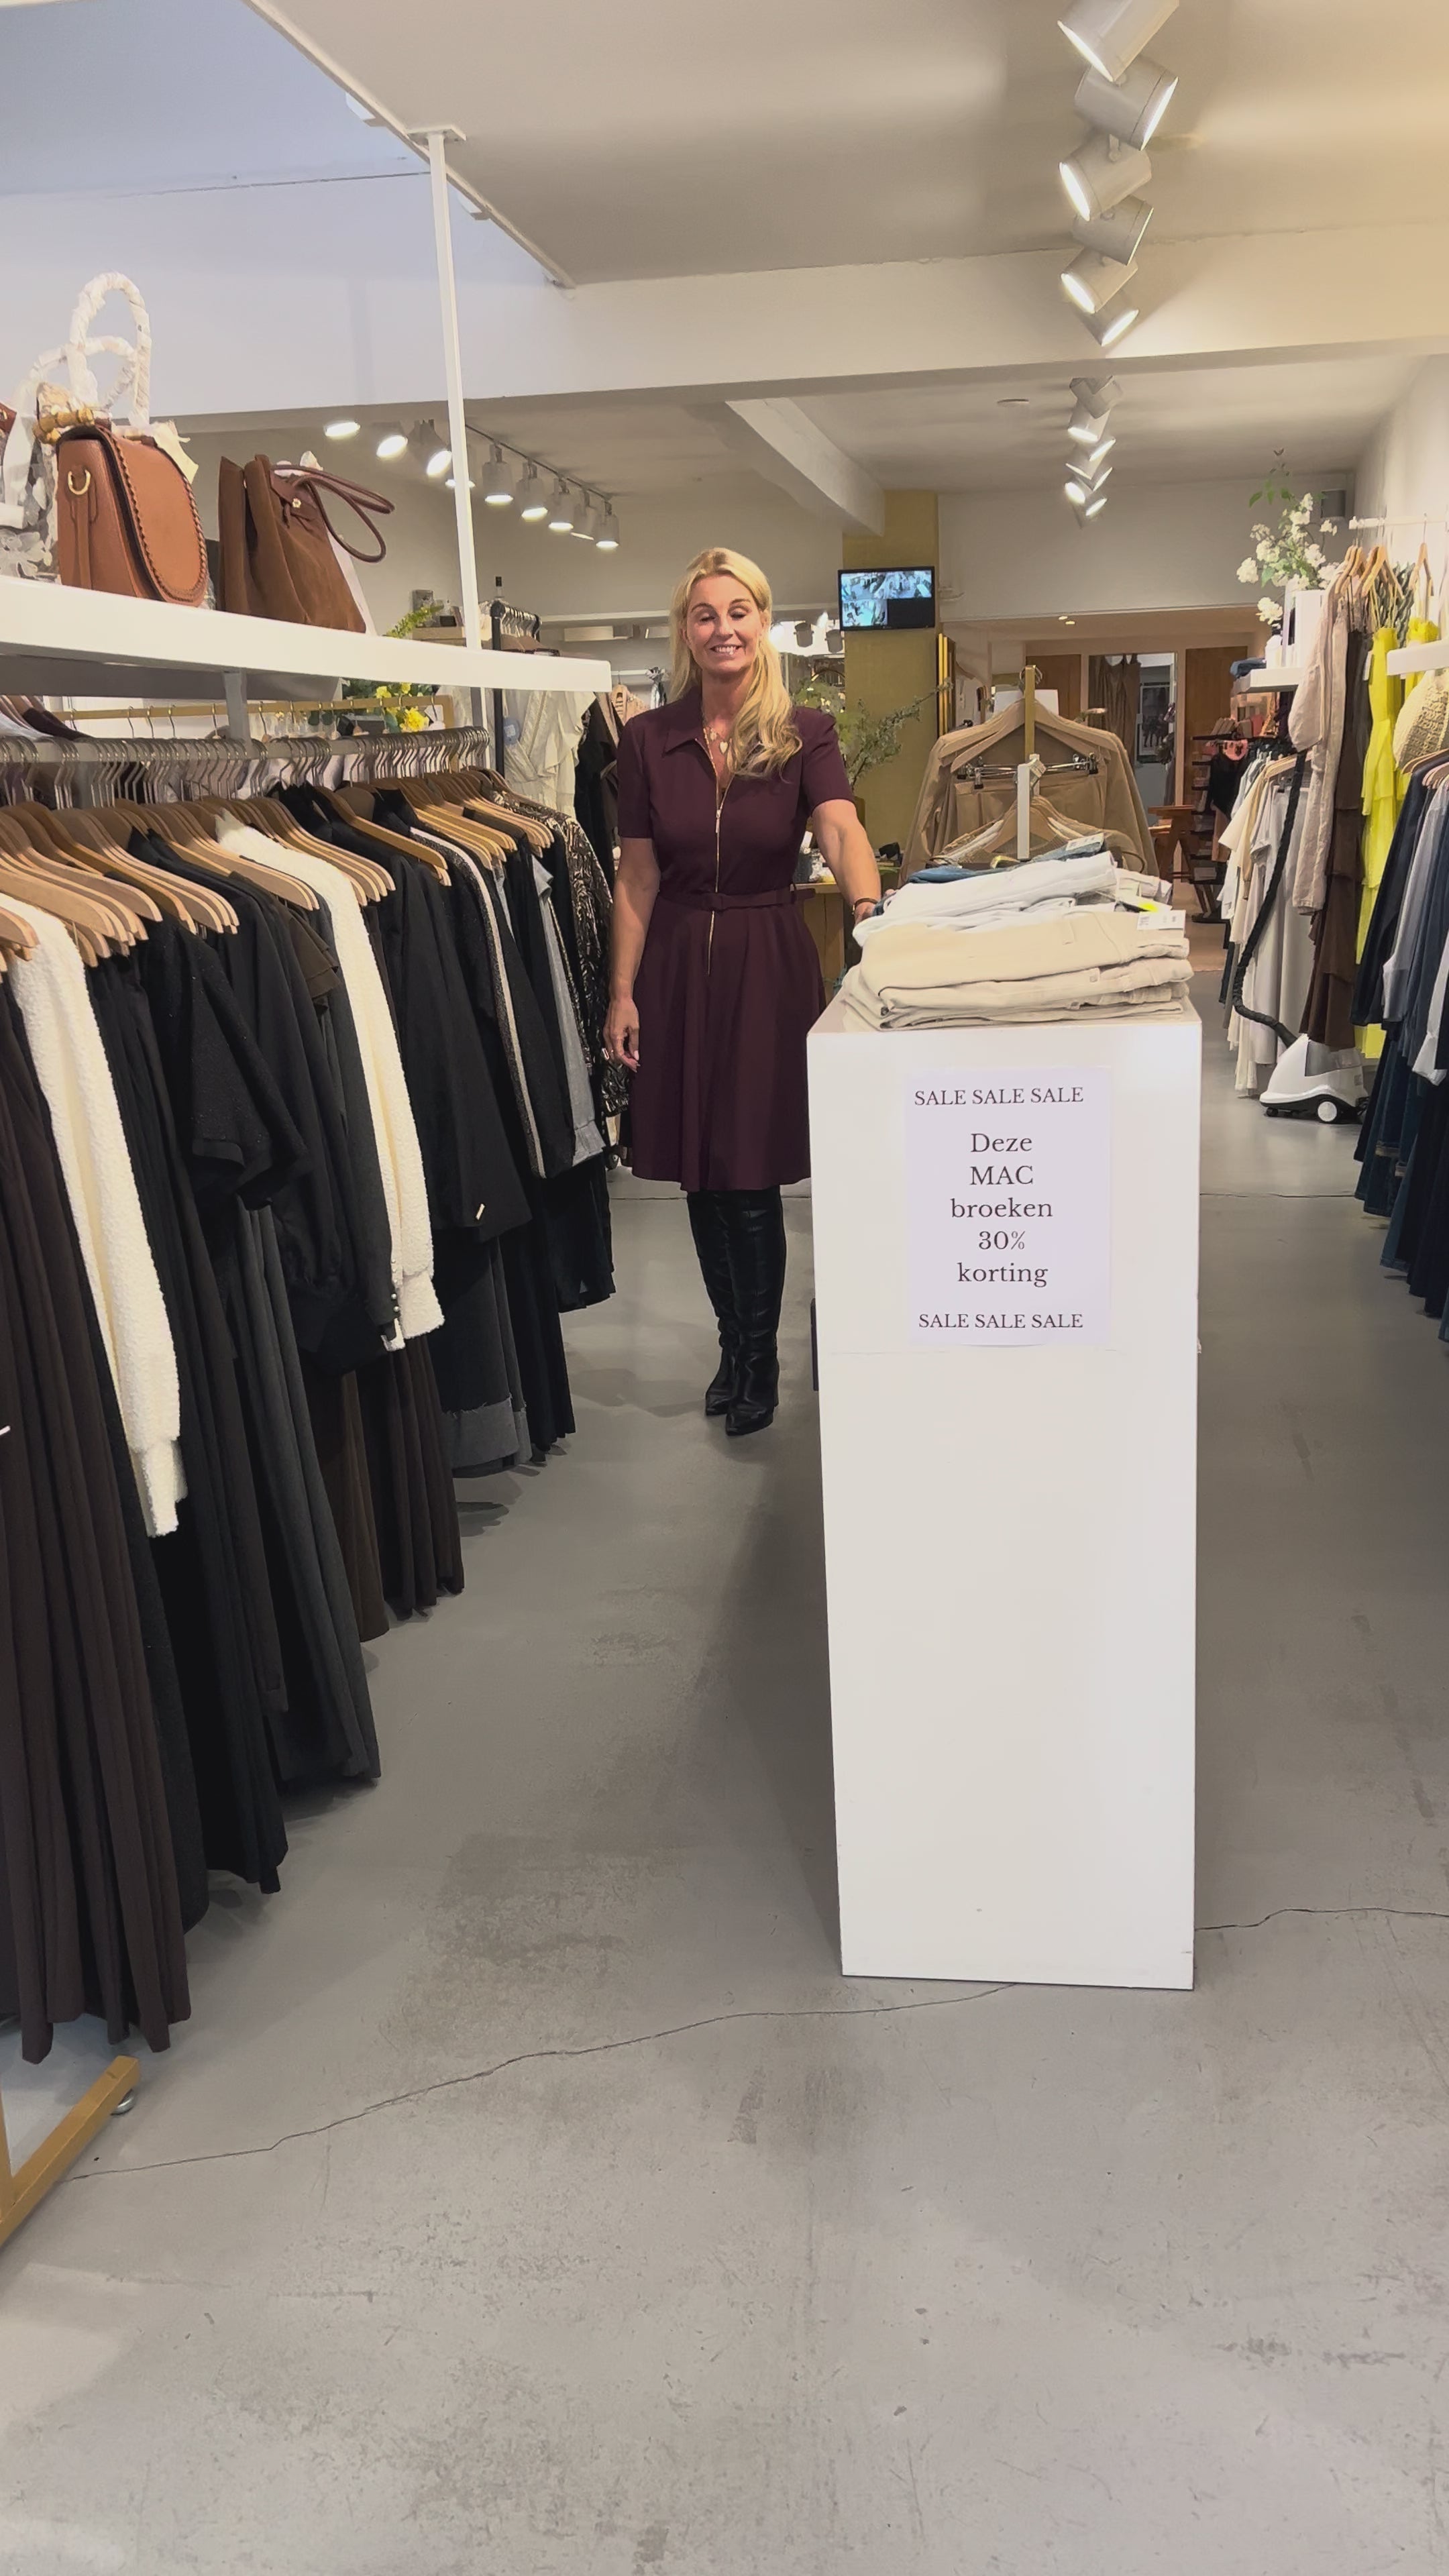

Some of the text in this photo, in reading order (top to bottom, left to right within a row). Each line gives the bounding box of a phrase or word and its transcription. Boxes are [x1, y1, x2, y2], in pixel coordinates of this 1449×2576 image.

[914, 1087, 1084, 1106] SALE SALE SALE
[970, 1133, 1032, 1152] Deze
[969, 1165, 1034, 1185] MAC
[950, 1197, 1053, 1218] broeken
[978, 1230, 1026, 1250] 30%
[957, 1262, 1049, 1288] korting
[918, 1313, 1083, 1329] SALE SALE SALE
